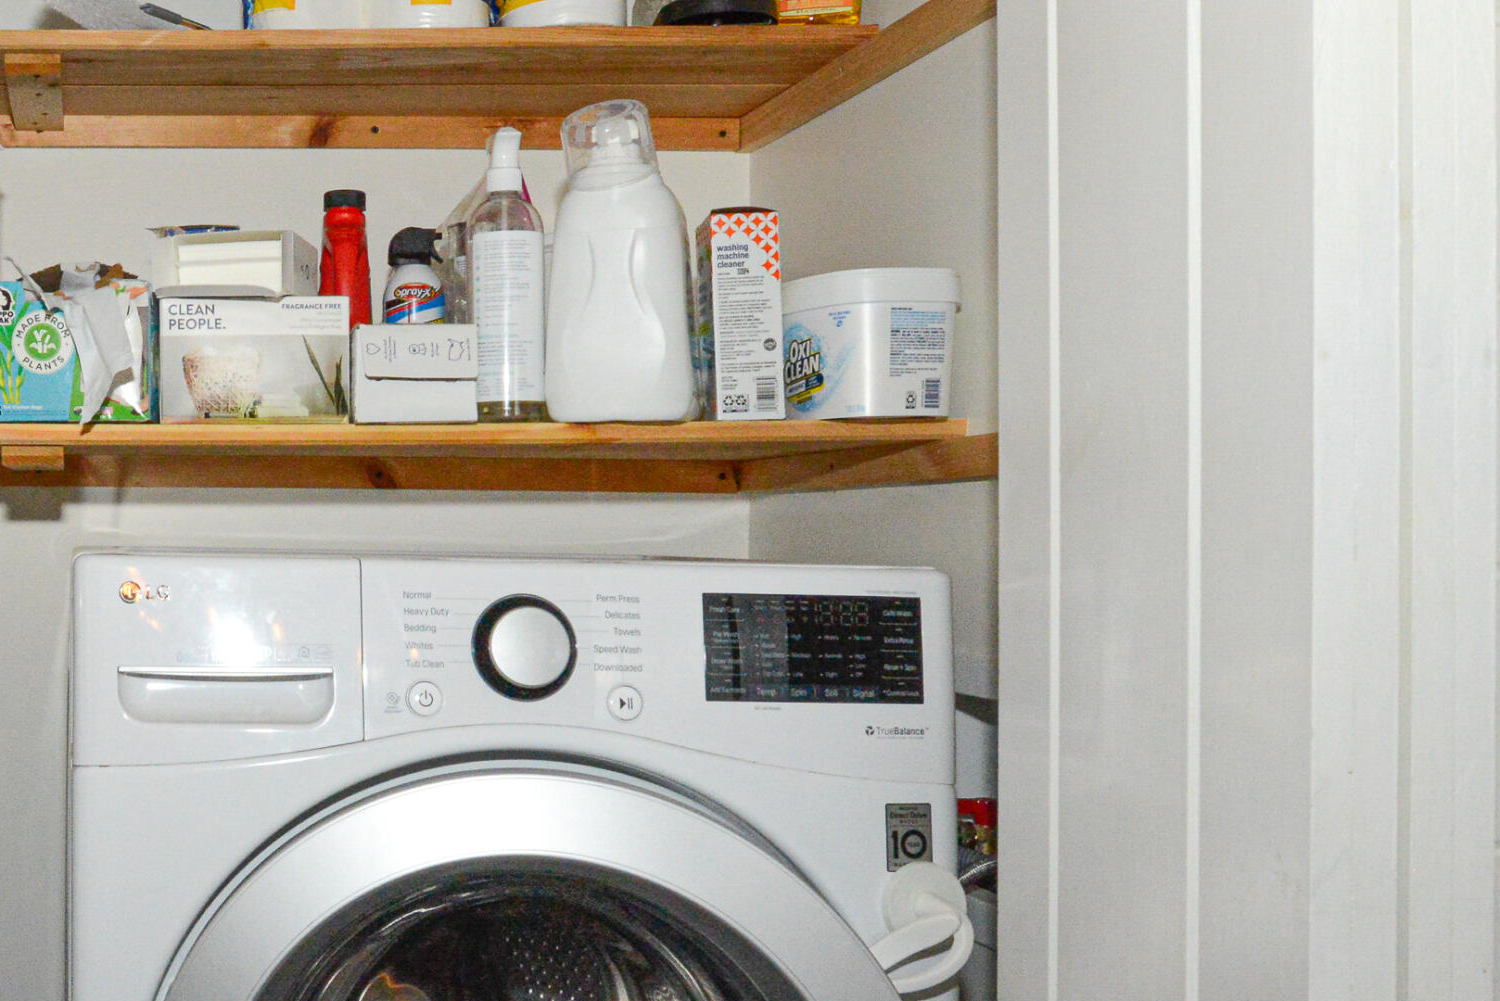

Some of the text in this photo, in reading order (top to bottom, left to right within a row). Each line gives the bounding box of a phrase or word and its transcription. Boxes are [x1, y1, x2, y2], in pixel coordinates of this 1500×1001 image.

[717, 244, 749, 252] washing
[717, 252, 749, 260] machine
[168, 304, 216, 316] CLEAN
[16, 313, 70, 338] MADE FROM
[169, 318, 226, 330] PEOPLE.
[790, 340, 812, 363] OXI
[23, 356, 65, 371] PLANTS
[784, 354, 821, 384] CLEAN
[146, 585, 170, 600] LG
[403, 591, 431, 599] Normal
[618, 595, 640, 603] Press
[404, 607, 449, 616] Heavy Duty
[605, 611, 640, 620] Delicates
[404, 624, 436, 633] Bedding
[614, 627, 641, 636] Towels
[405, 641, 433, 649] Whites
[594, 644, 642, 654] Speed Wash
[406, 660, 444, 668] Tub Clean
[594, 663, 643, 672] Downloaded
[891, 829, 927, 859] 10
